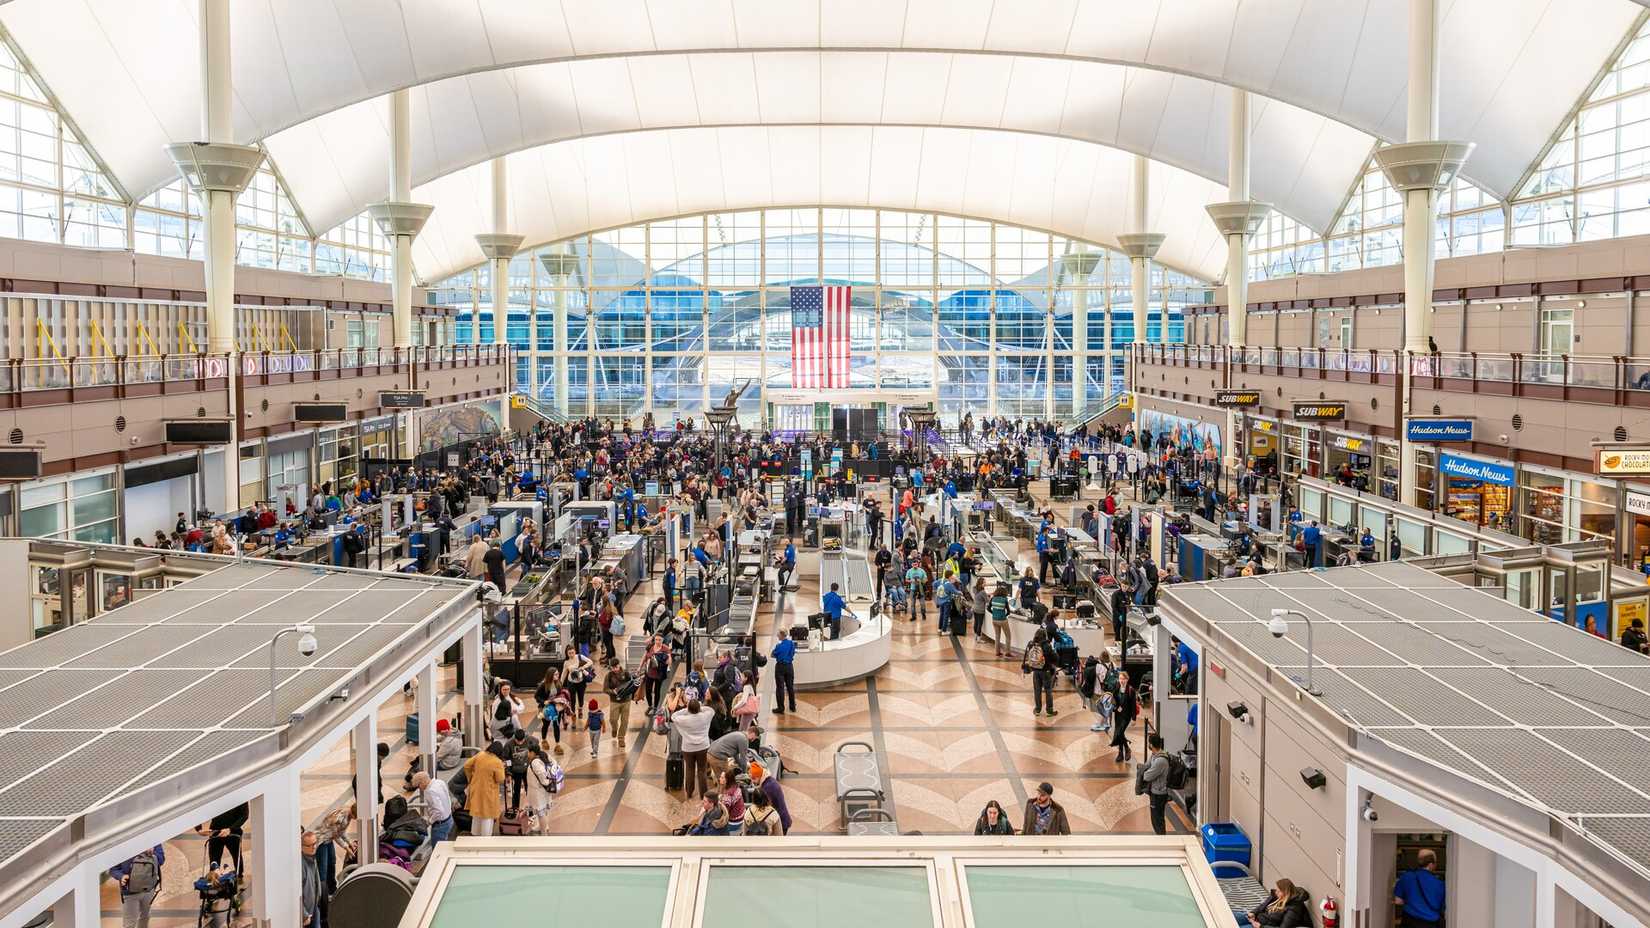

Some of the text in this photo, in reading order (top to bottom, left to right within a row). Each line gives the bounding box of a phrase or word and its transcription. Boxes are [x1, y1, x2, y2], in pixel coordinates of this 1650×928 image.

[1218, 394, 1258, 403] SUBWAY
[1296, 407, 1343, 417] SUBWAY
[1253, 420, 1272, 431] SUBWAY
[1410, 425, 1470, 434] Hudson News
[1334, 436, 1362, 451] SUBWAY
[1445, 459, 1511, 481] Hudson News
[1628, 497, 1646, 509] ROCKY
